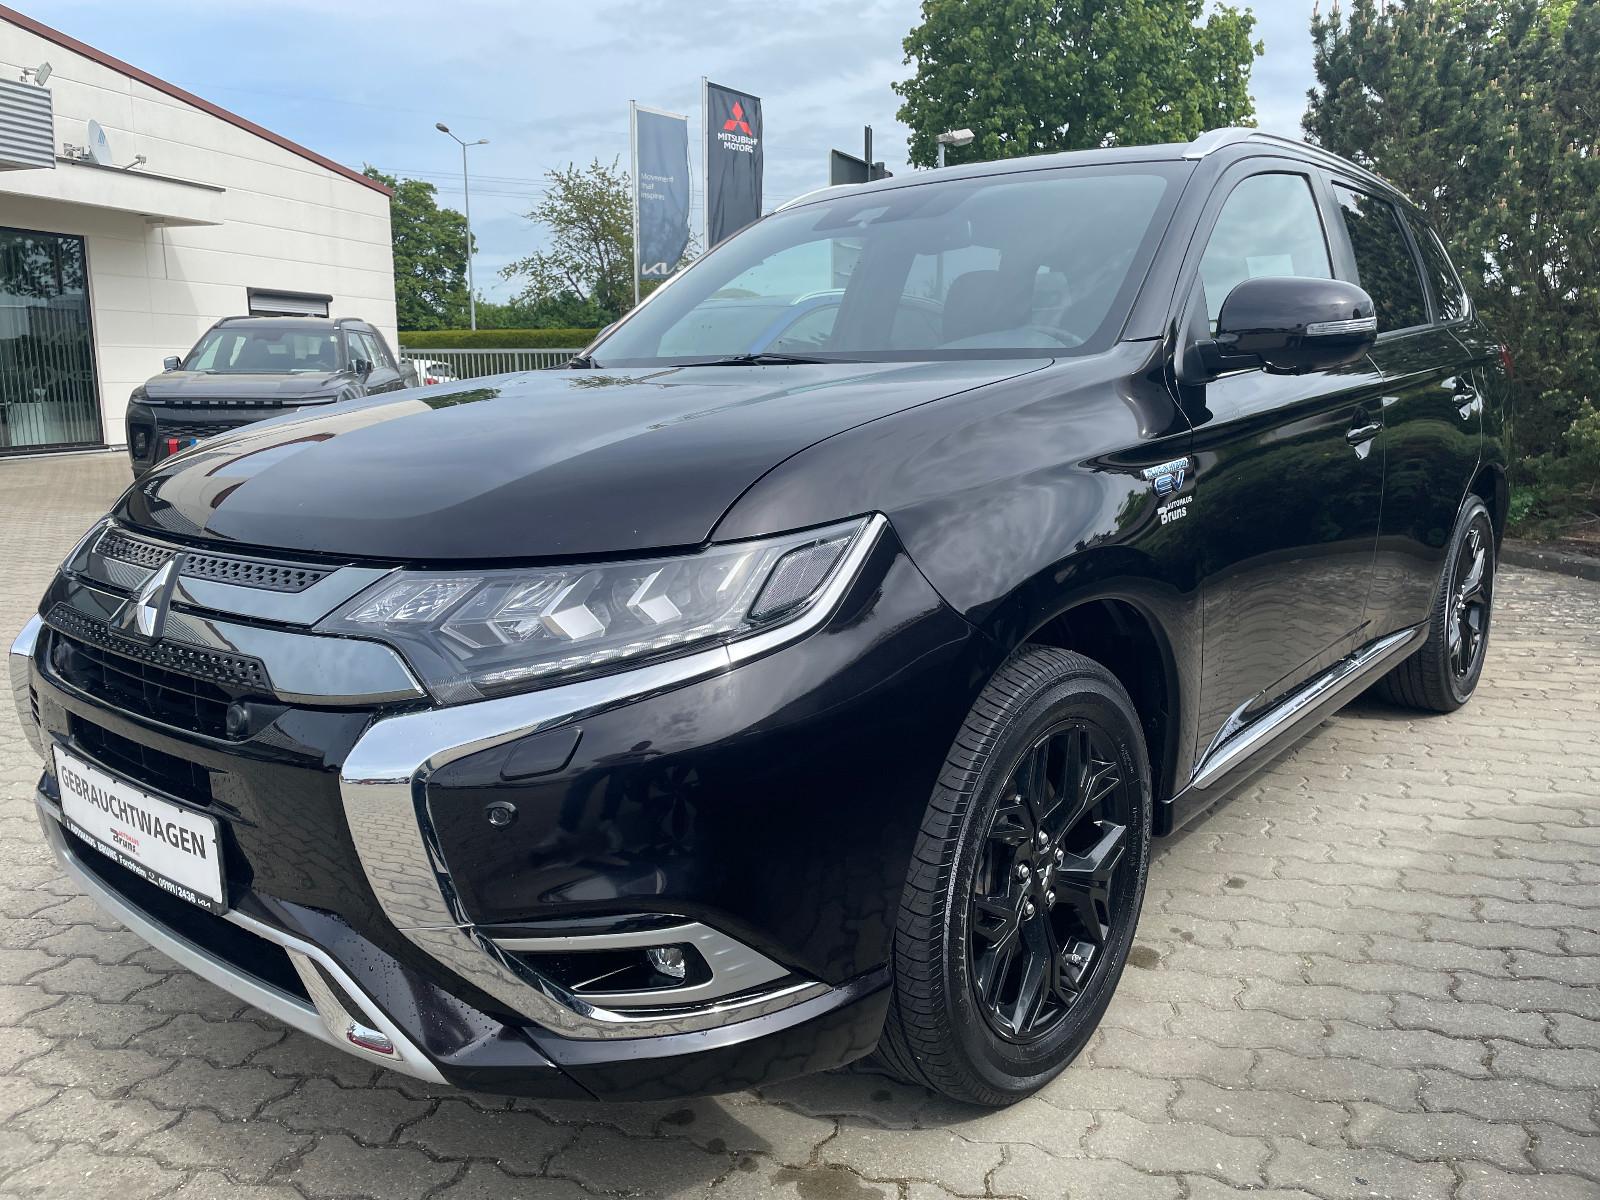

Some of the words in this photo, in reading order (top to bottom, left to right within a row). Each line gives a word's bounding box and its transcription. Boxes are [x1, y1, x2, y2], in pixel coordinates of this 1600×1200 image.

[723, 141, 753, 153] MOTORS
[641, 172, 674, 183] Movement
[1154, 469, 1185, 498] EV
[1167, 495, 1193, 510] AUTOHAUS
[1157, 506, 1187, 525] Bruns
[60, 765, 207, 859] GEBRAUCHTWAGEN
